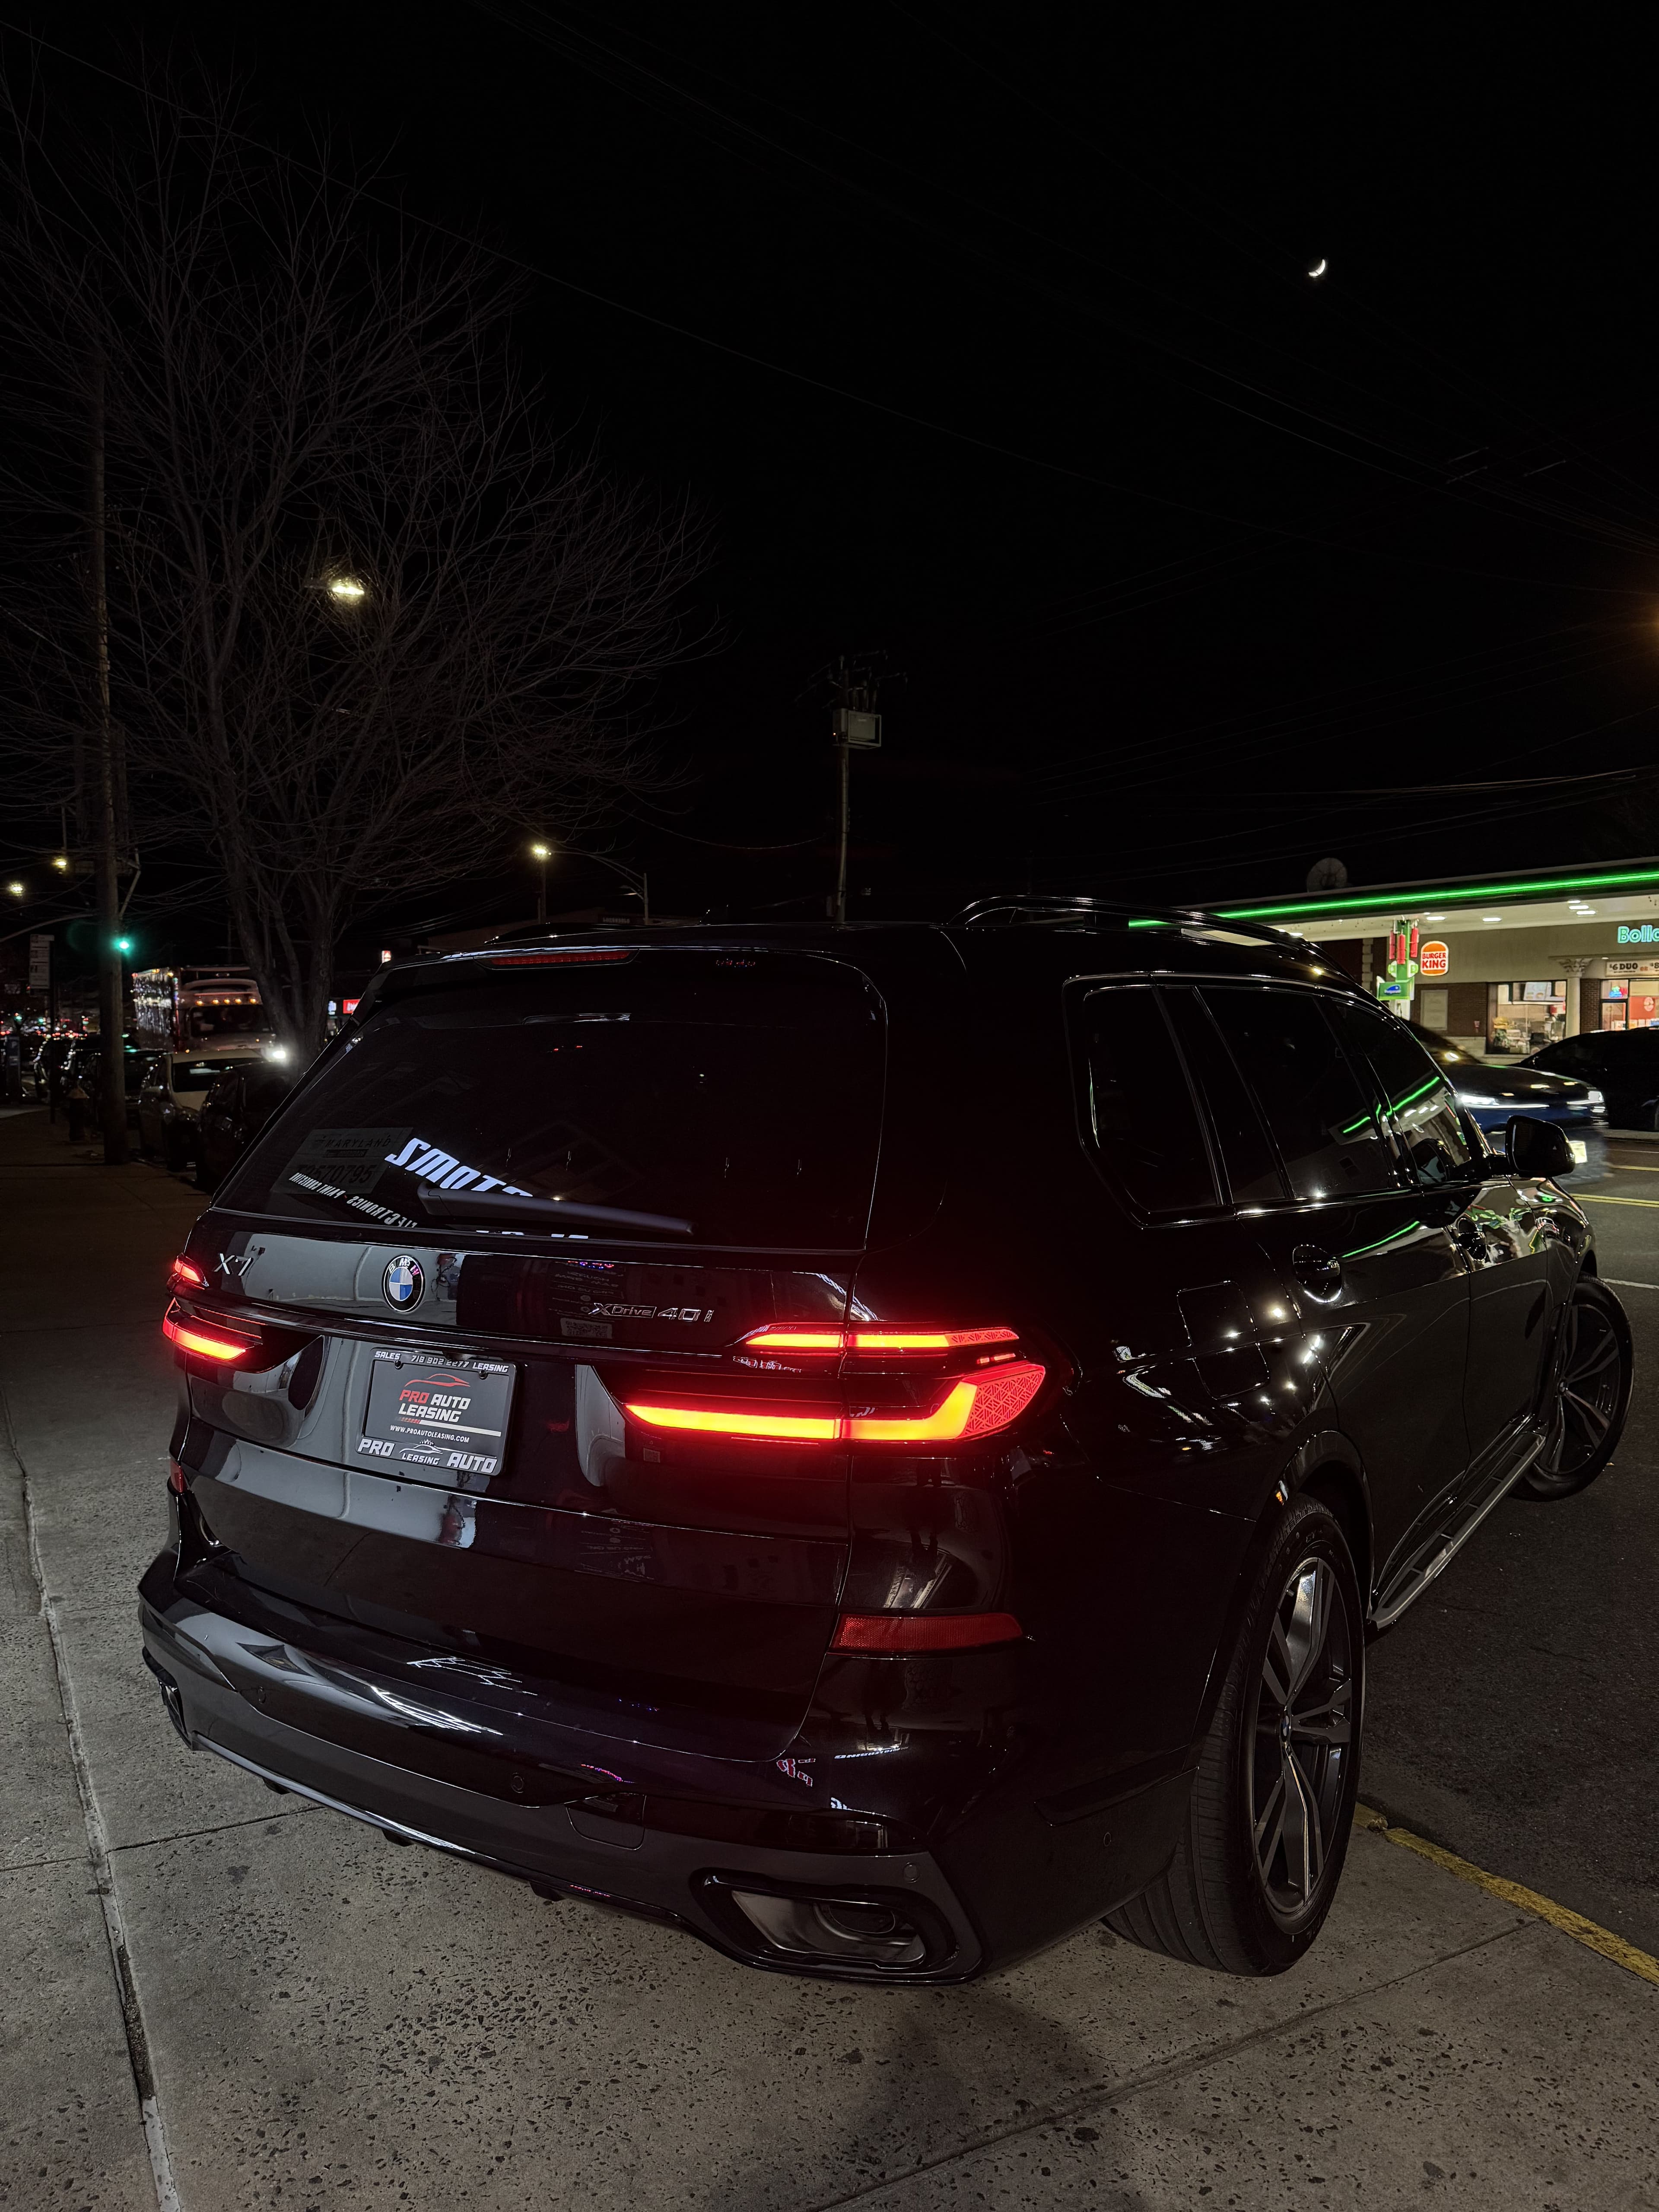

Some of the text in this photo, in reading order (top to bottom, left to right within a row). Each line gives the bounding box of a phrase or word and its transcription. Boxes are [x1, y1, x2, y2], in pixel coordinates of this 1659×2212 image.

[1422, 960, 1446, 969] KING
[325, 1138, 391, 1147] MARYLAND
[214, 1253, 254, 1276] X7
[388, 1258, 420, 1276] BMW
[374, 1351, 401, 1360] SALES
[446, 1360, 470, 1368] 2277
[472, 1362, 509, 1373] LEASING
[399, 1389, 471, 1410] PRO AUTO
[398, 1403, 461, 1423] LEASING
[390, 1425, 470, 1443] WWW.PROAUTOLEASING.COM
[357, 1438, 498, 1474] PRO AUTO
[401, 1452, 440, 1465] LEASING
